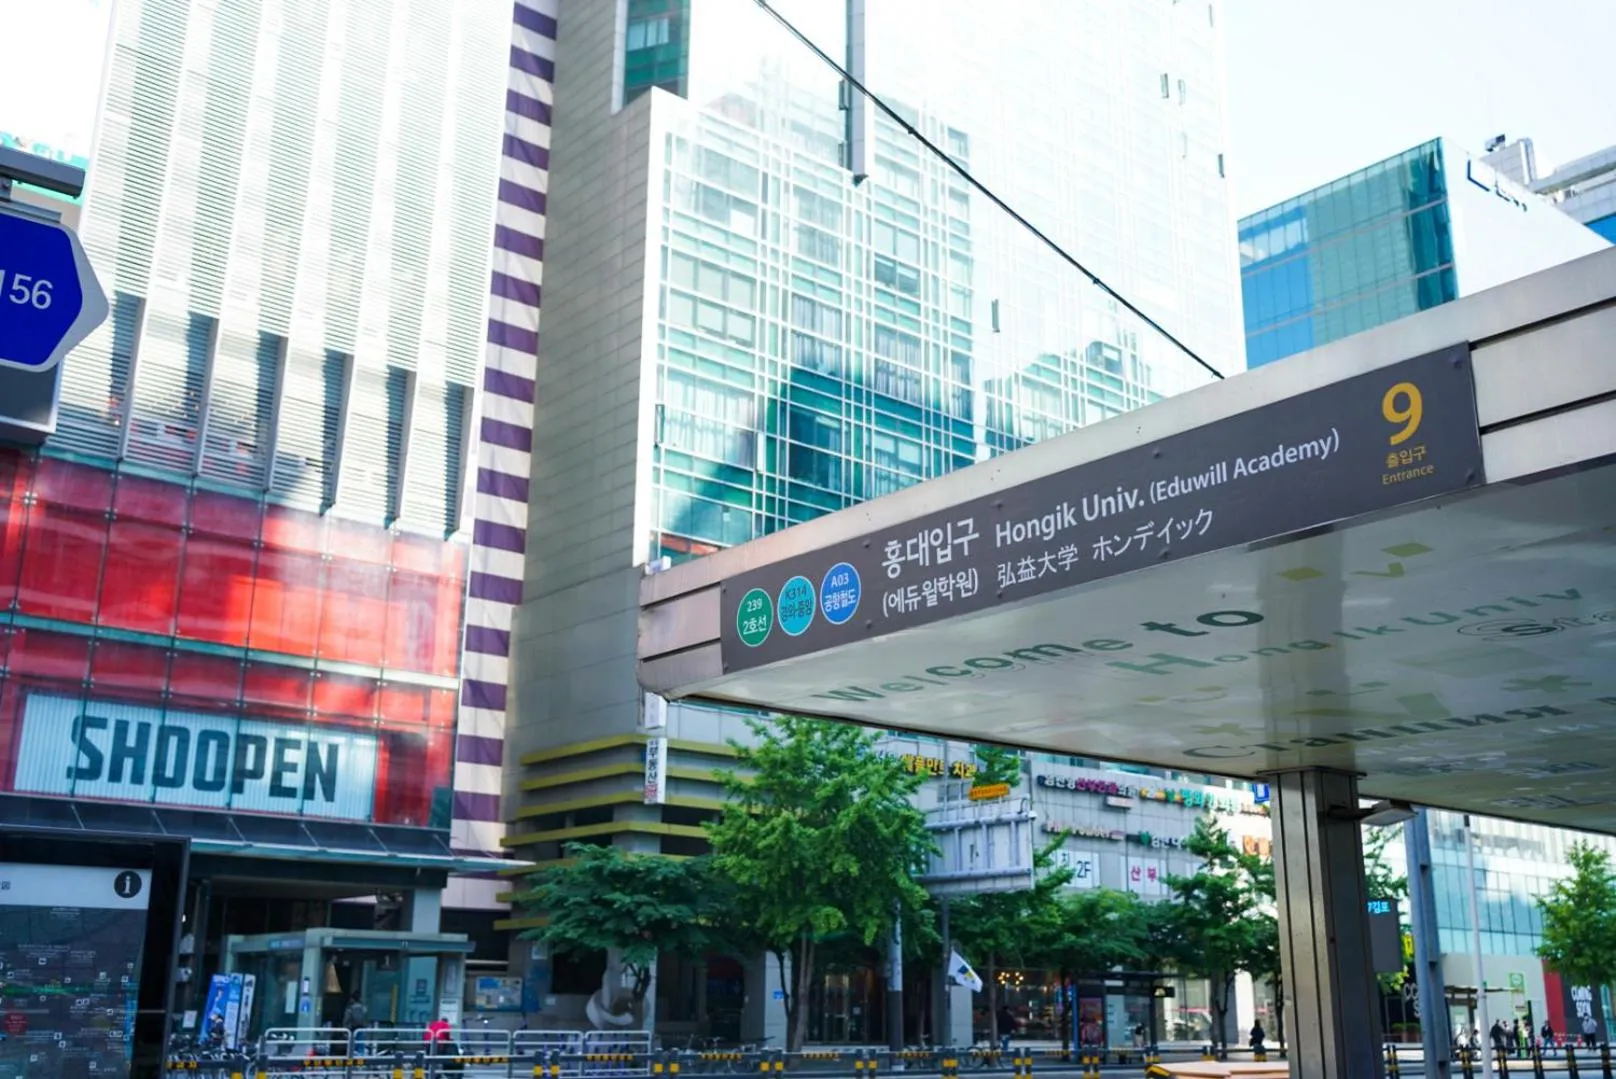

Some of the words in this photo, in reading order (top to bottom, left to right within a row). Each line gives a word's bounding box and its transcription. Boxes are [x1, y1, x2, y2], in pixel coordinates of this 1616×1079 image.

[1382, 382, 1423, 446] 9
[1382, 464, 1435, 485] Entrance
[1385, 445, 1427, 469] 출입구
[995, 502, 1078, 549] Hongik
[1082, 486, 1145, 522] Univ.
[1150, 461, 1228, 505] (Eduwill
[1233, 427, 1340, 480] Academy)
[881, 517, 980, 579] 홍대입구
[831, 573, 850, 588] A03
[997, 543, 1080, 589] 弘益大学
[746, 598, 763, 613] 239
[823, 589, 857, 613] 공항철도
[882, 567, 979, 618] (에듀윌학원)
[742, 615, 767, 635] 2호선
[811, 636, 1134, 702] Welcome
[1139, 610, 1265, 638] to
[66, 715, 340, 803] SHOOPEN
[1077, 860, 1092, 878] 2F
